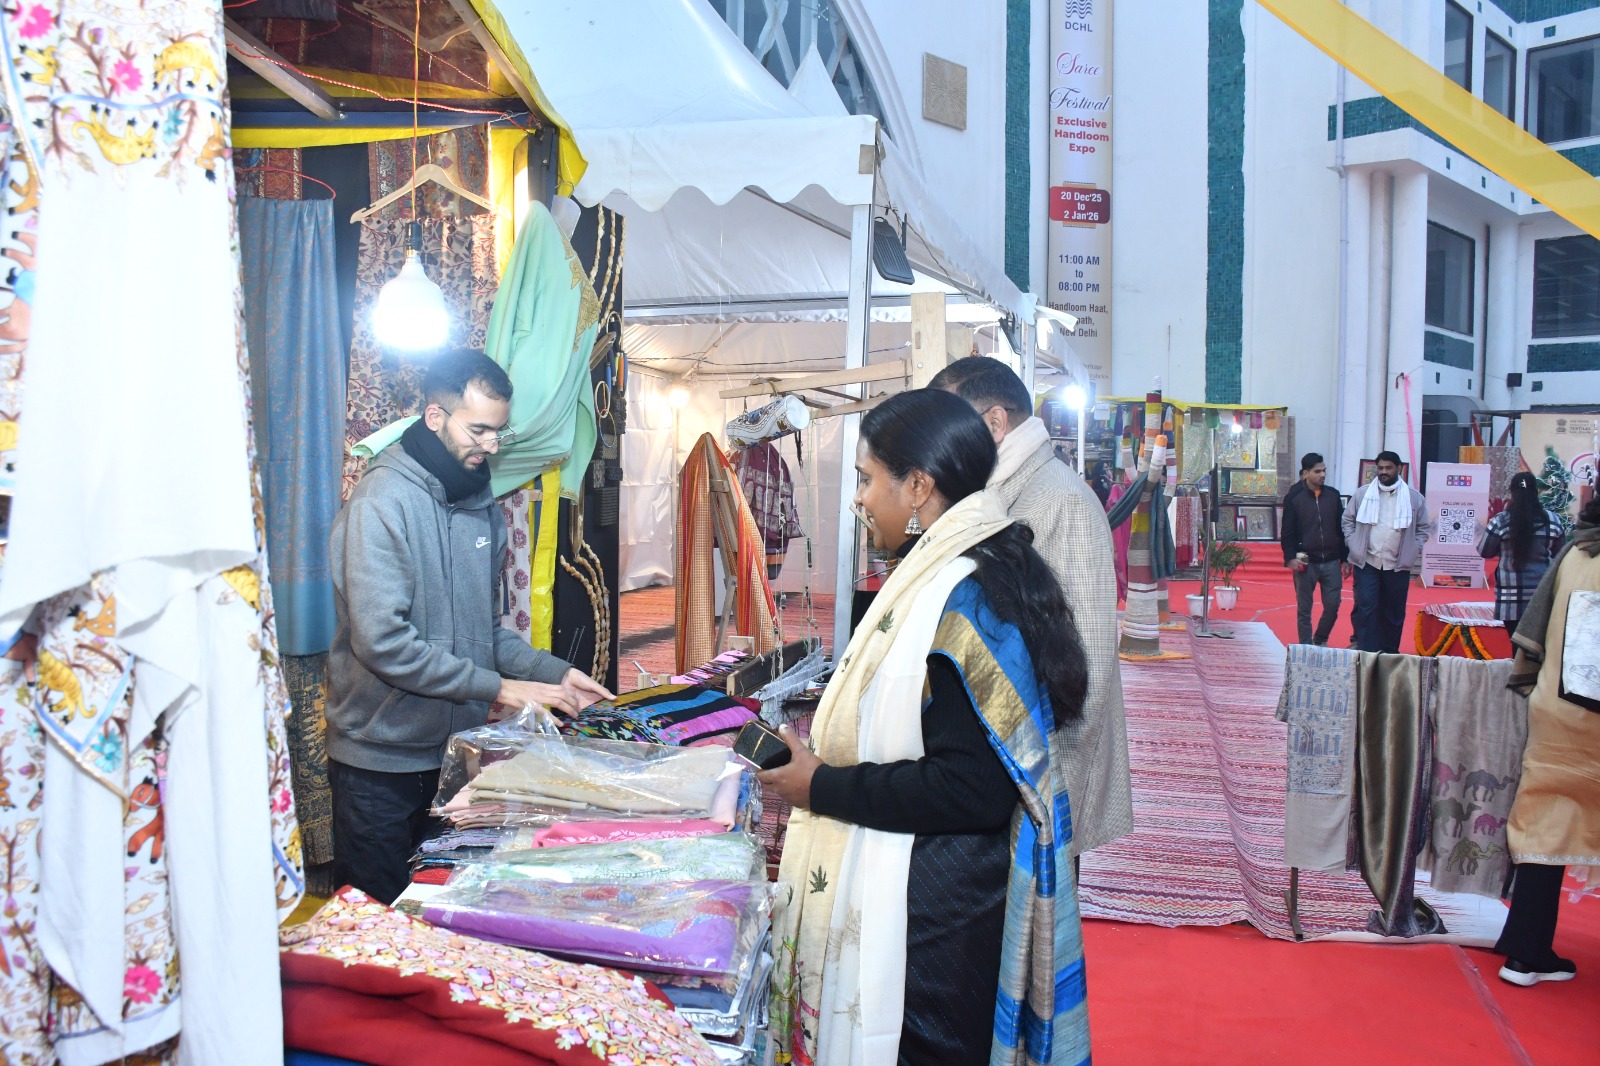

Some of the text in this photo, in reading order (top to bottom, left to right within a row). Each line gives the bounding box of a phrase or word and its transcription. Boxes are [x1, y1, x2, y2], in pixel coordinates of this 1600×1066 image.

[1064, 21, 1093, 32] DCHL
[1056, 52, 1101, 77] Saree
[1049, 86, 1111, 112] Festival
[1057, 116, 1107, 129] Exclusive
[1054, 129, 1109, 142] Handloom
[1069, 143, 1096, 155] Expo
[1061, 191, 1102, 203] 20 Dec'25
[1077, 202, 1086, 211] to
[1063, 210, 1099, 221] 2 Jan'26
[1058, 254, 1100, 266] 11:00 AM
[1075, 269, 1084, 278] to
[1058, 281, 1100, 293] 08:00 PM
[1048, 301, 1087, 312] Handloom
[1059, 327, 1098, 338] New Delhi
